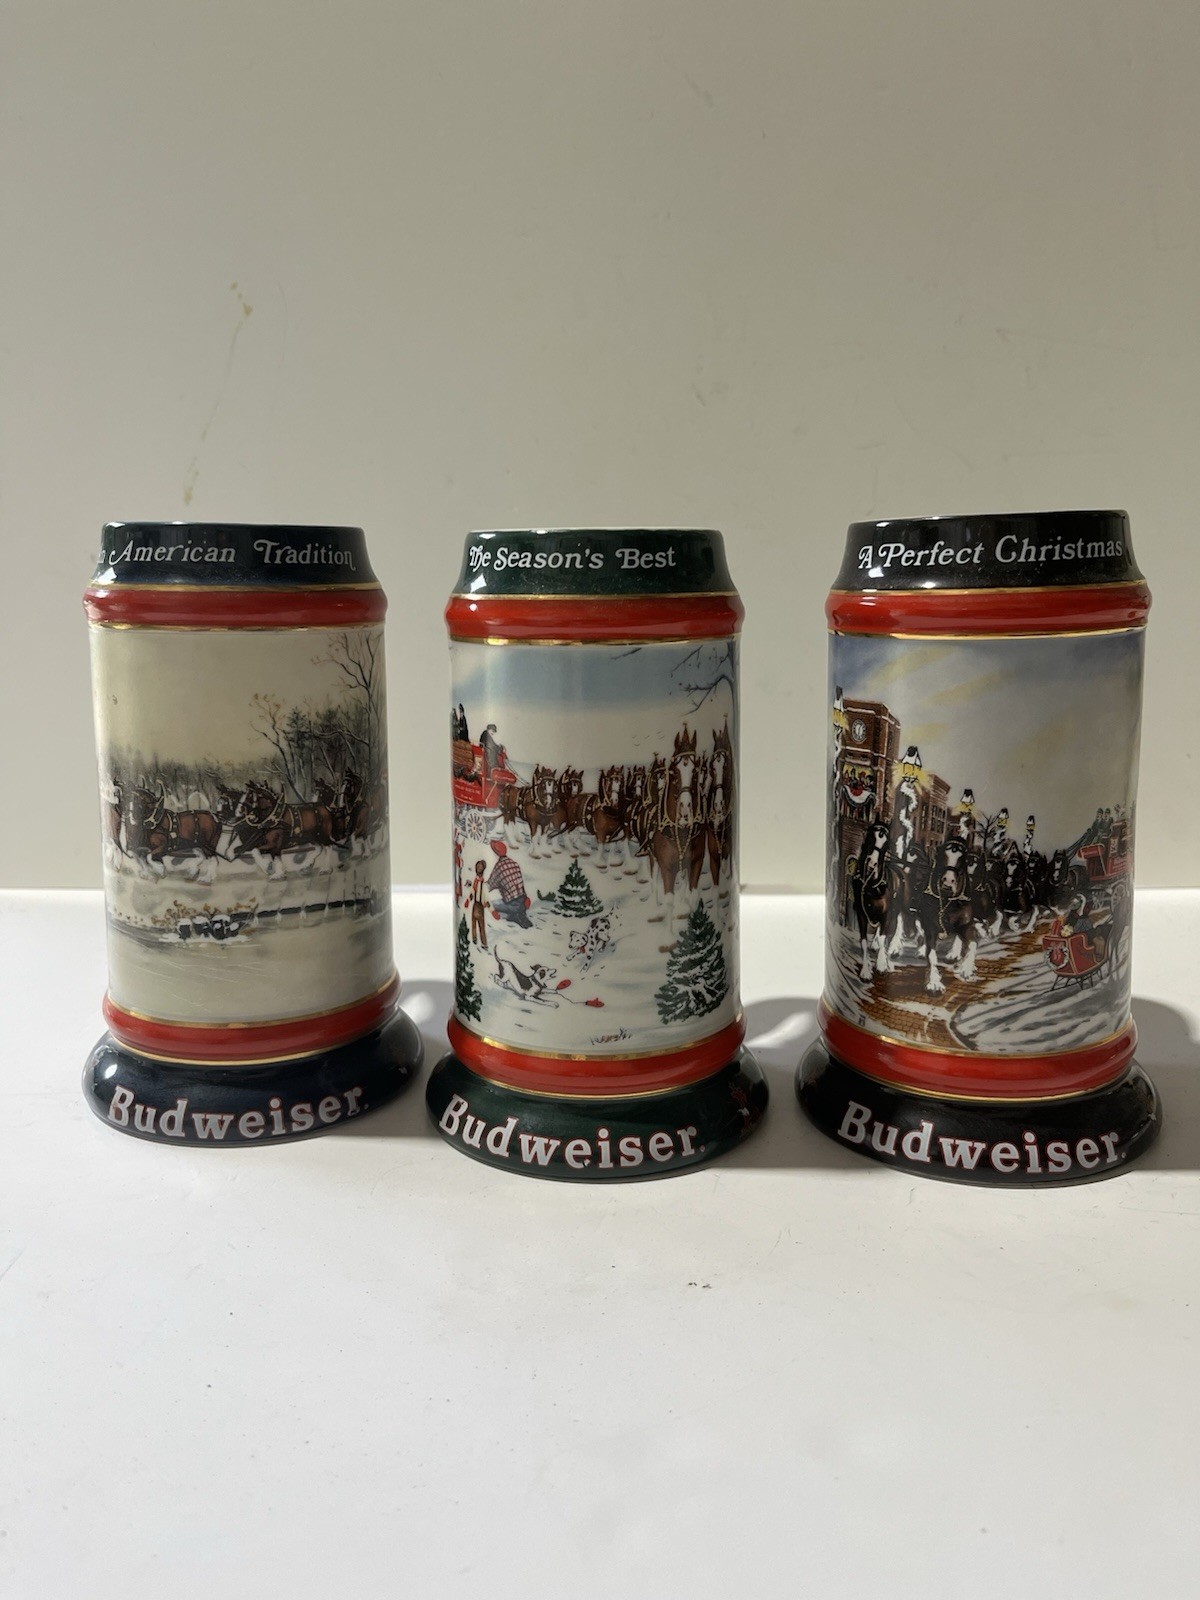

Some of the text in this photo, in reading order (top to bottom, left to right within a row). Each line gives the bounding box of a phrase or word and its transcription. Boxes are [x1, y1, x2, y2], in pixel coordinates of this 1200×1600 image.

[109, 539, 236, 566] American
[253, 539, 356, 571] Tradition
[469, 545, 676, 572] The Season's Best
[858, 534, 1123, 569] A Perfect Christmas
